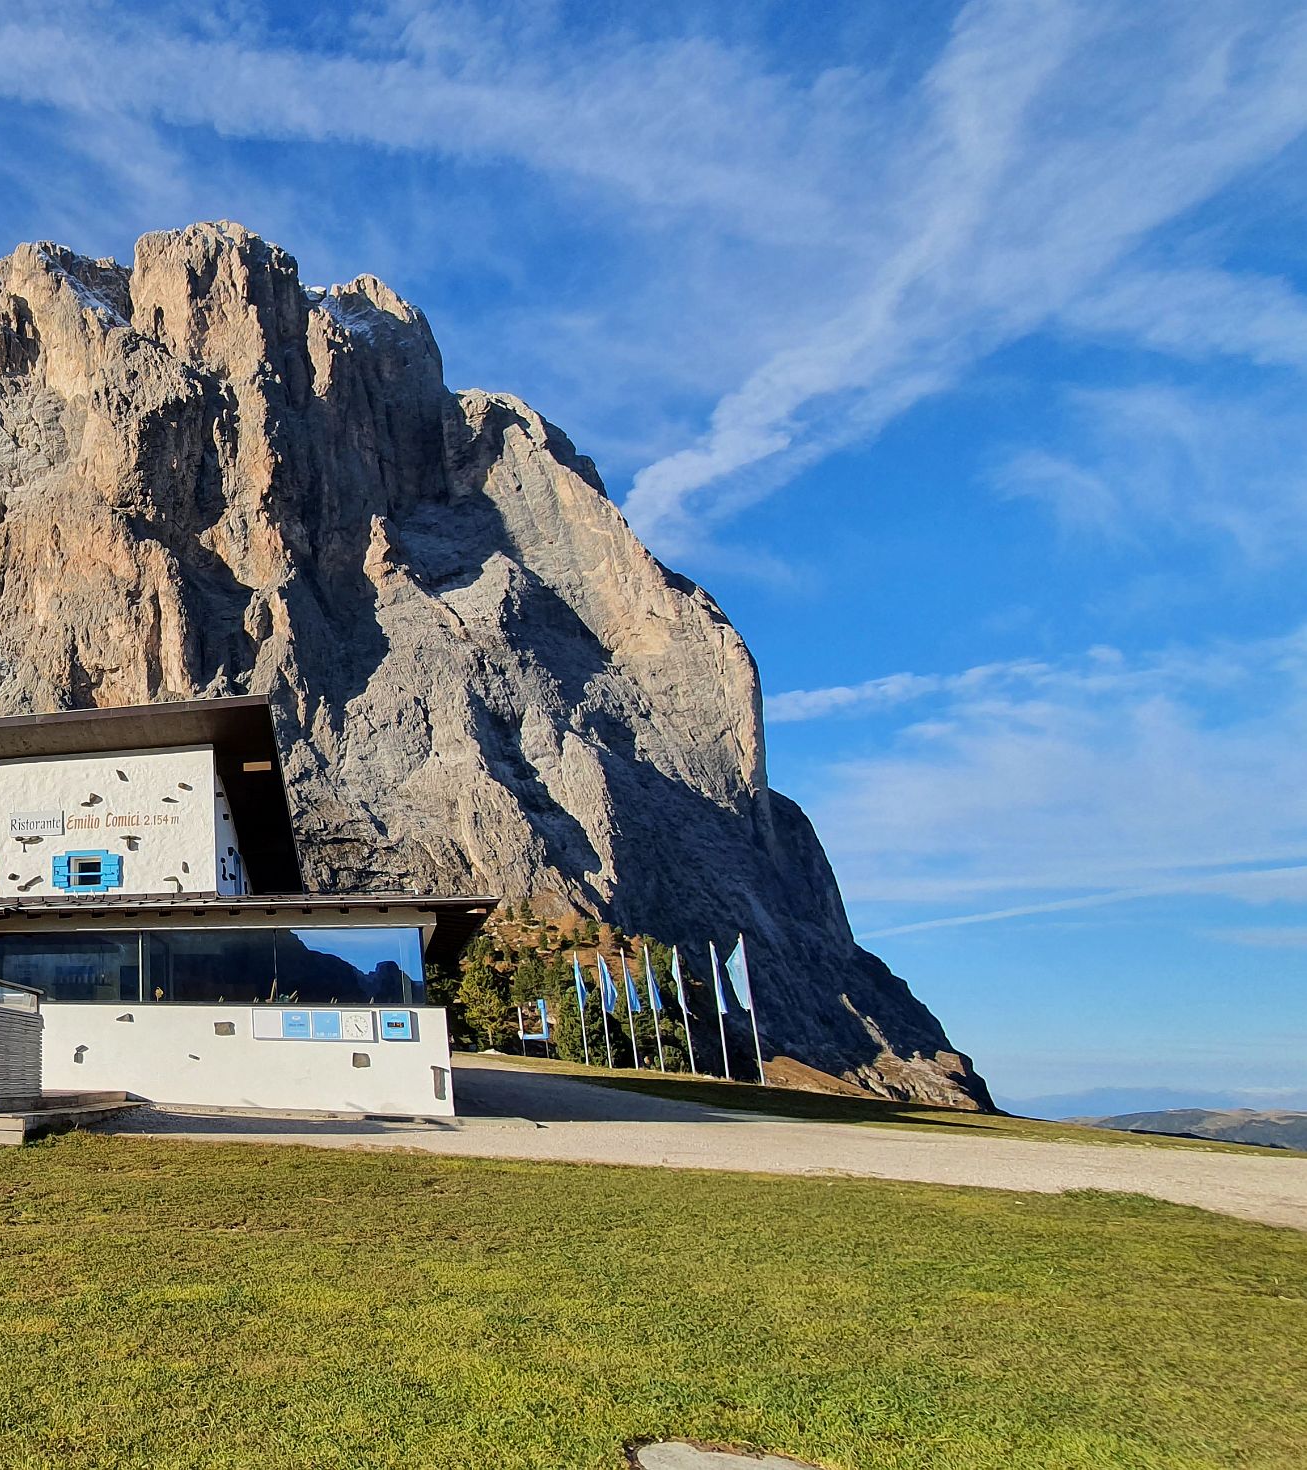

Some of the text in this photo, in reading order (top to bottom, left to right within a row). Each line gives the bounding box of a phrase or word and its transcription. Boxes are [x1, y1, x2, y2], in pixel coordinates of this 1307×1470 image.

[10, 811, 180, 831] Ristorante Emilio Comici 2.154 m
